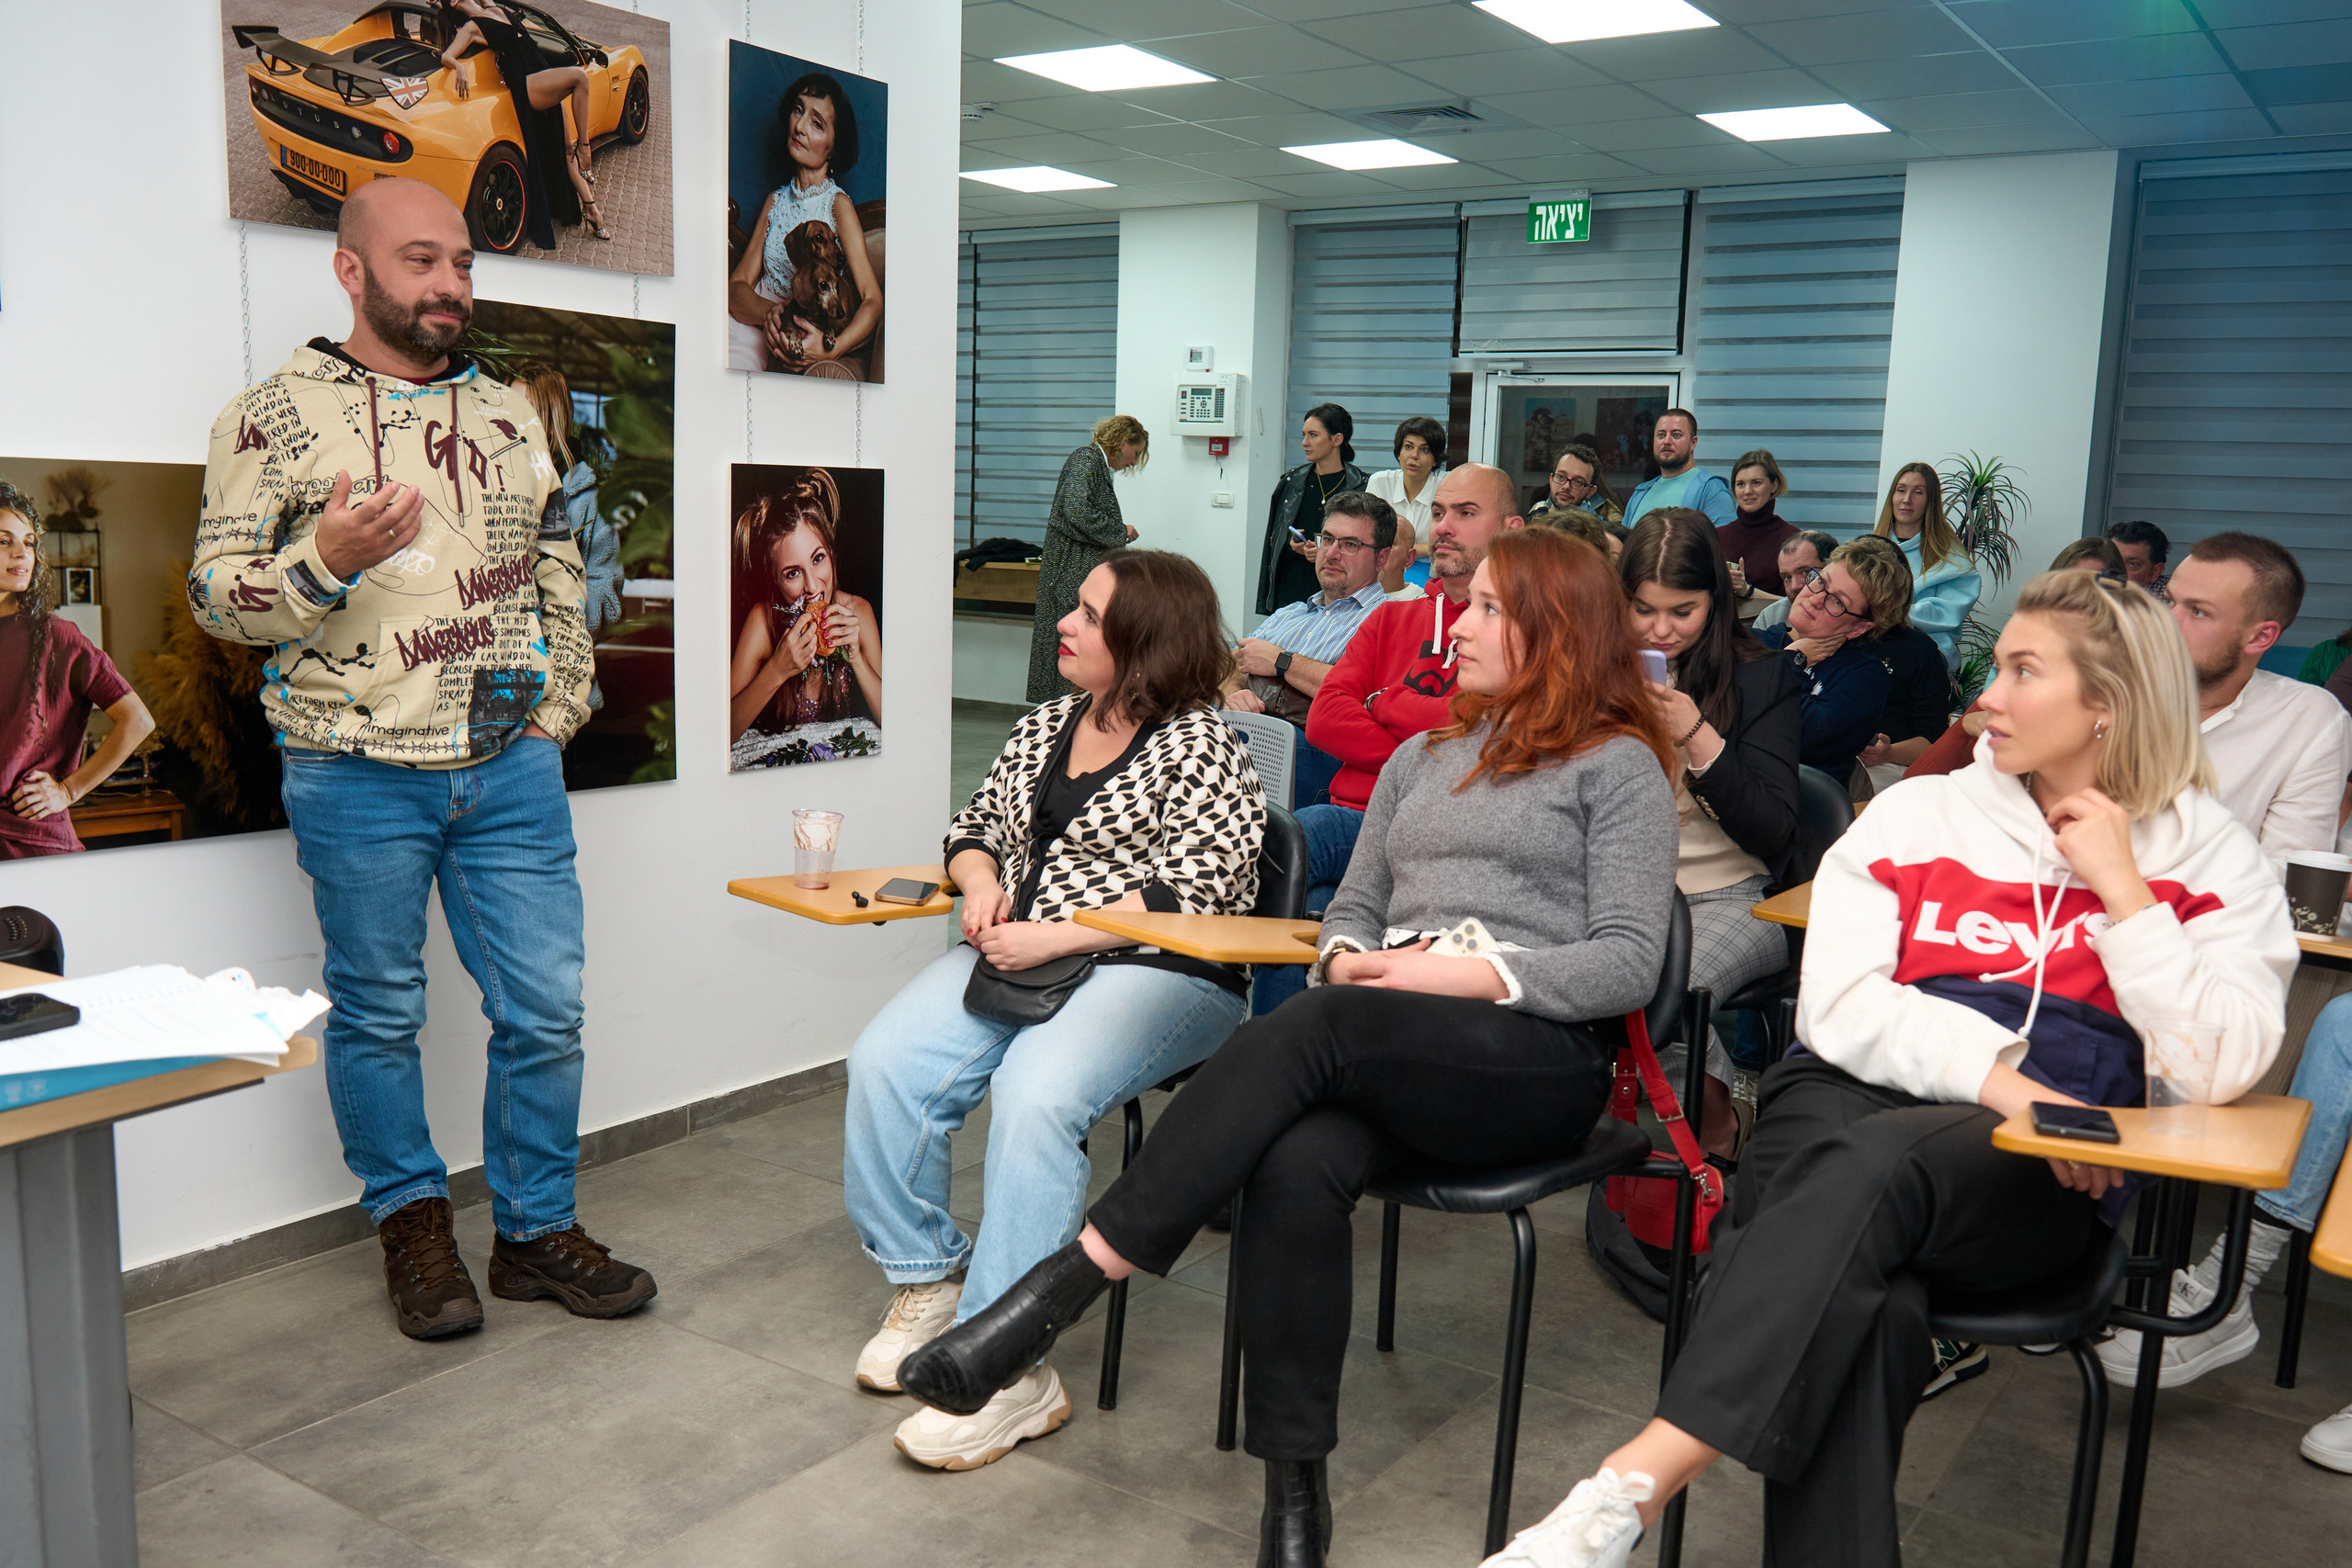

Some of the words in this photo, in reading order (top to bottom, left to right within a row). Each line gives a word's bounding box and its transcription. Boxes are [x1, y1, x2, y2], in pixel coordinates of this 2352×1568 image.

[270, 94, 340, 130] LOTUS
[1533, 203, 1584, 241] יציאה
[481, 493, 493, 503] THE
[495, 492, 509, 503] NEW
[482, 505, 503, 516] TOOK
[505, 505, 518, 515] OFF
[485, 529, 507, 542] THEIR
[514, 616, 528, 626] MID
[500, 627, 531, 638] SOMETIMES
[512, 638, 523, 649] OF
[481, 652, 497, 663] CAR
[434, 664, 473, 678] BECAUSE
[437, 689, 466, 701] SPRAY
[368, 719, 450, 739] imaginative
